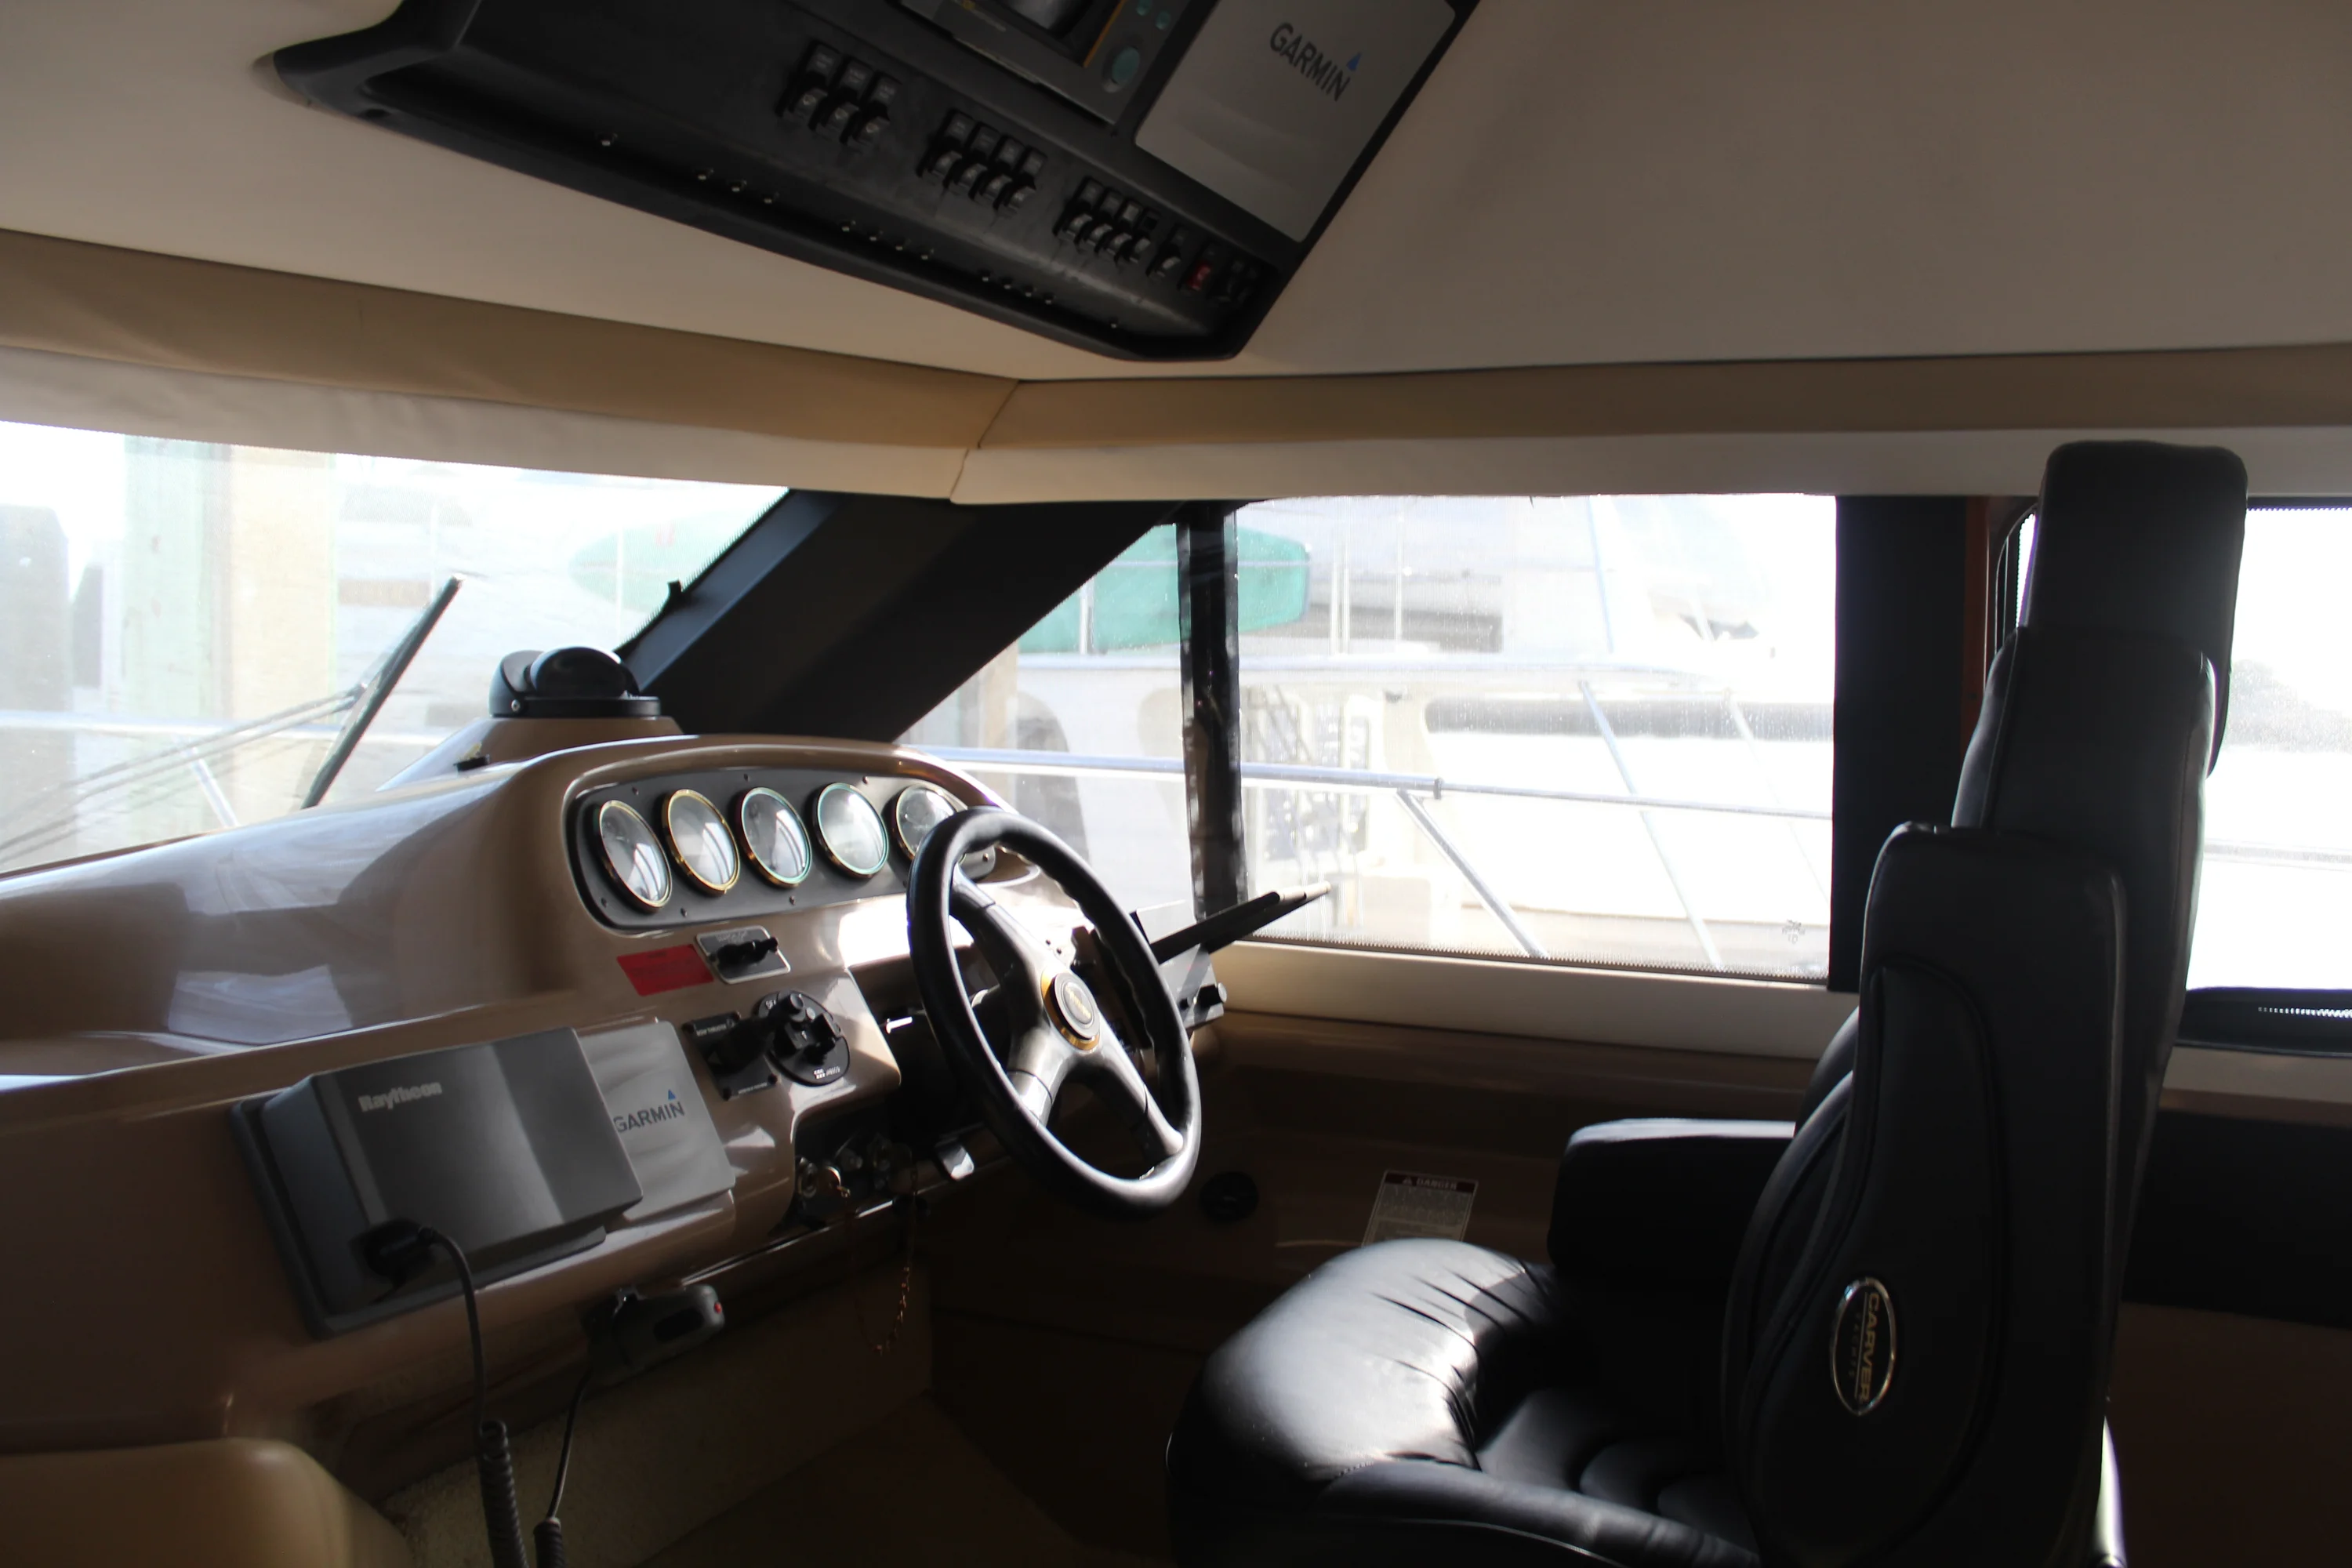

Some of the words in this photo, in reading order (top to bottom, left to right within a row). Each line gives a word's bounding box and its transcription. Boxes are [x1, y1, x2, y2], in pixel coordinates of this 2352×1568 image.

[1269, 22, 1351, 102] GARMIN
[358, 1082, 443, 1112] Raytheon
[612, 1102, 685, 1134] GARMIN
[1416, 1178, 1457, 1189] DANGER
[1859, 1292, 1879, 1403] CARVER
